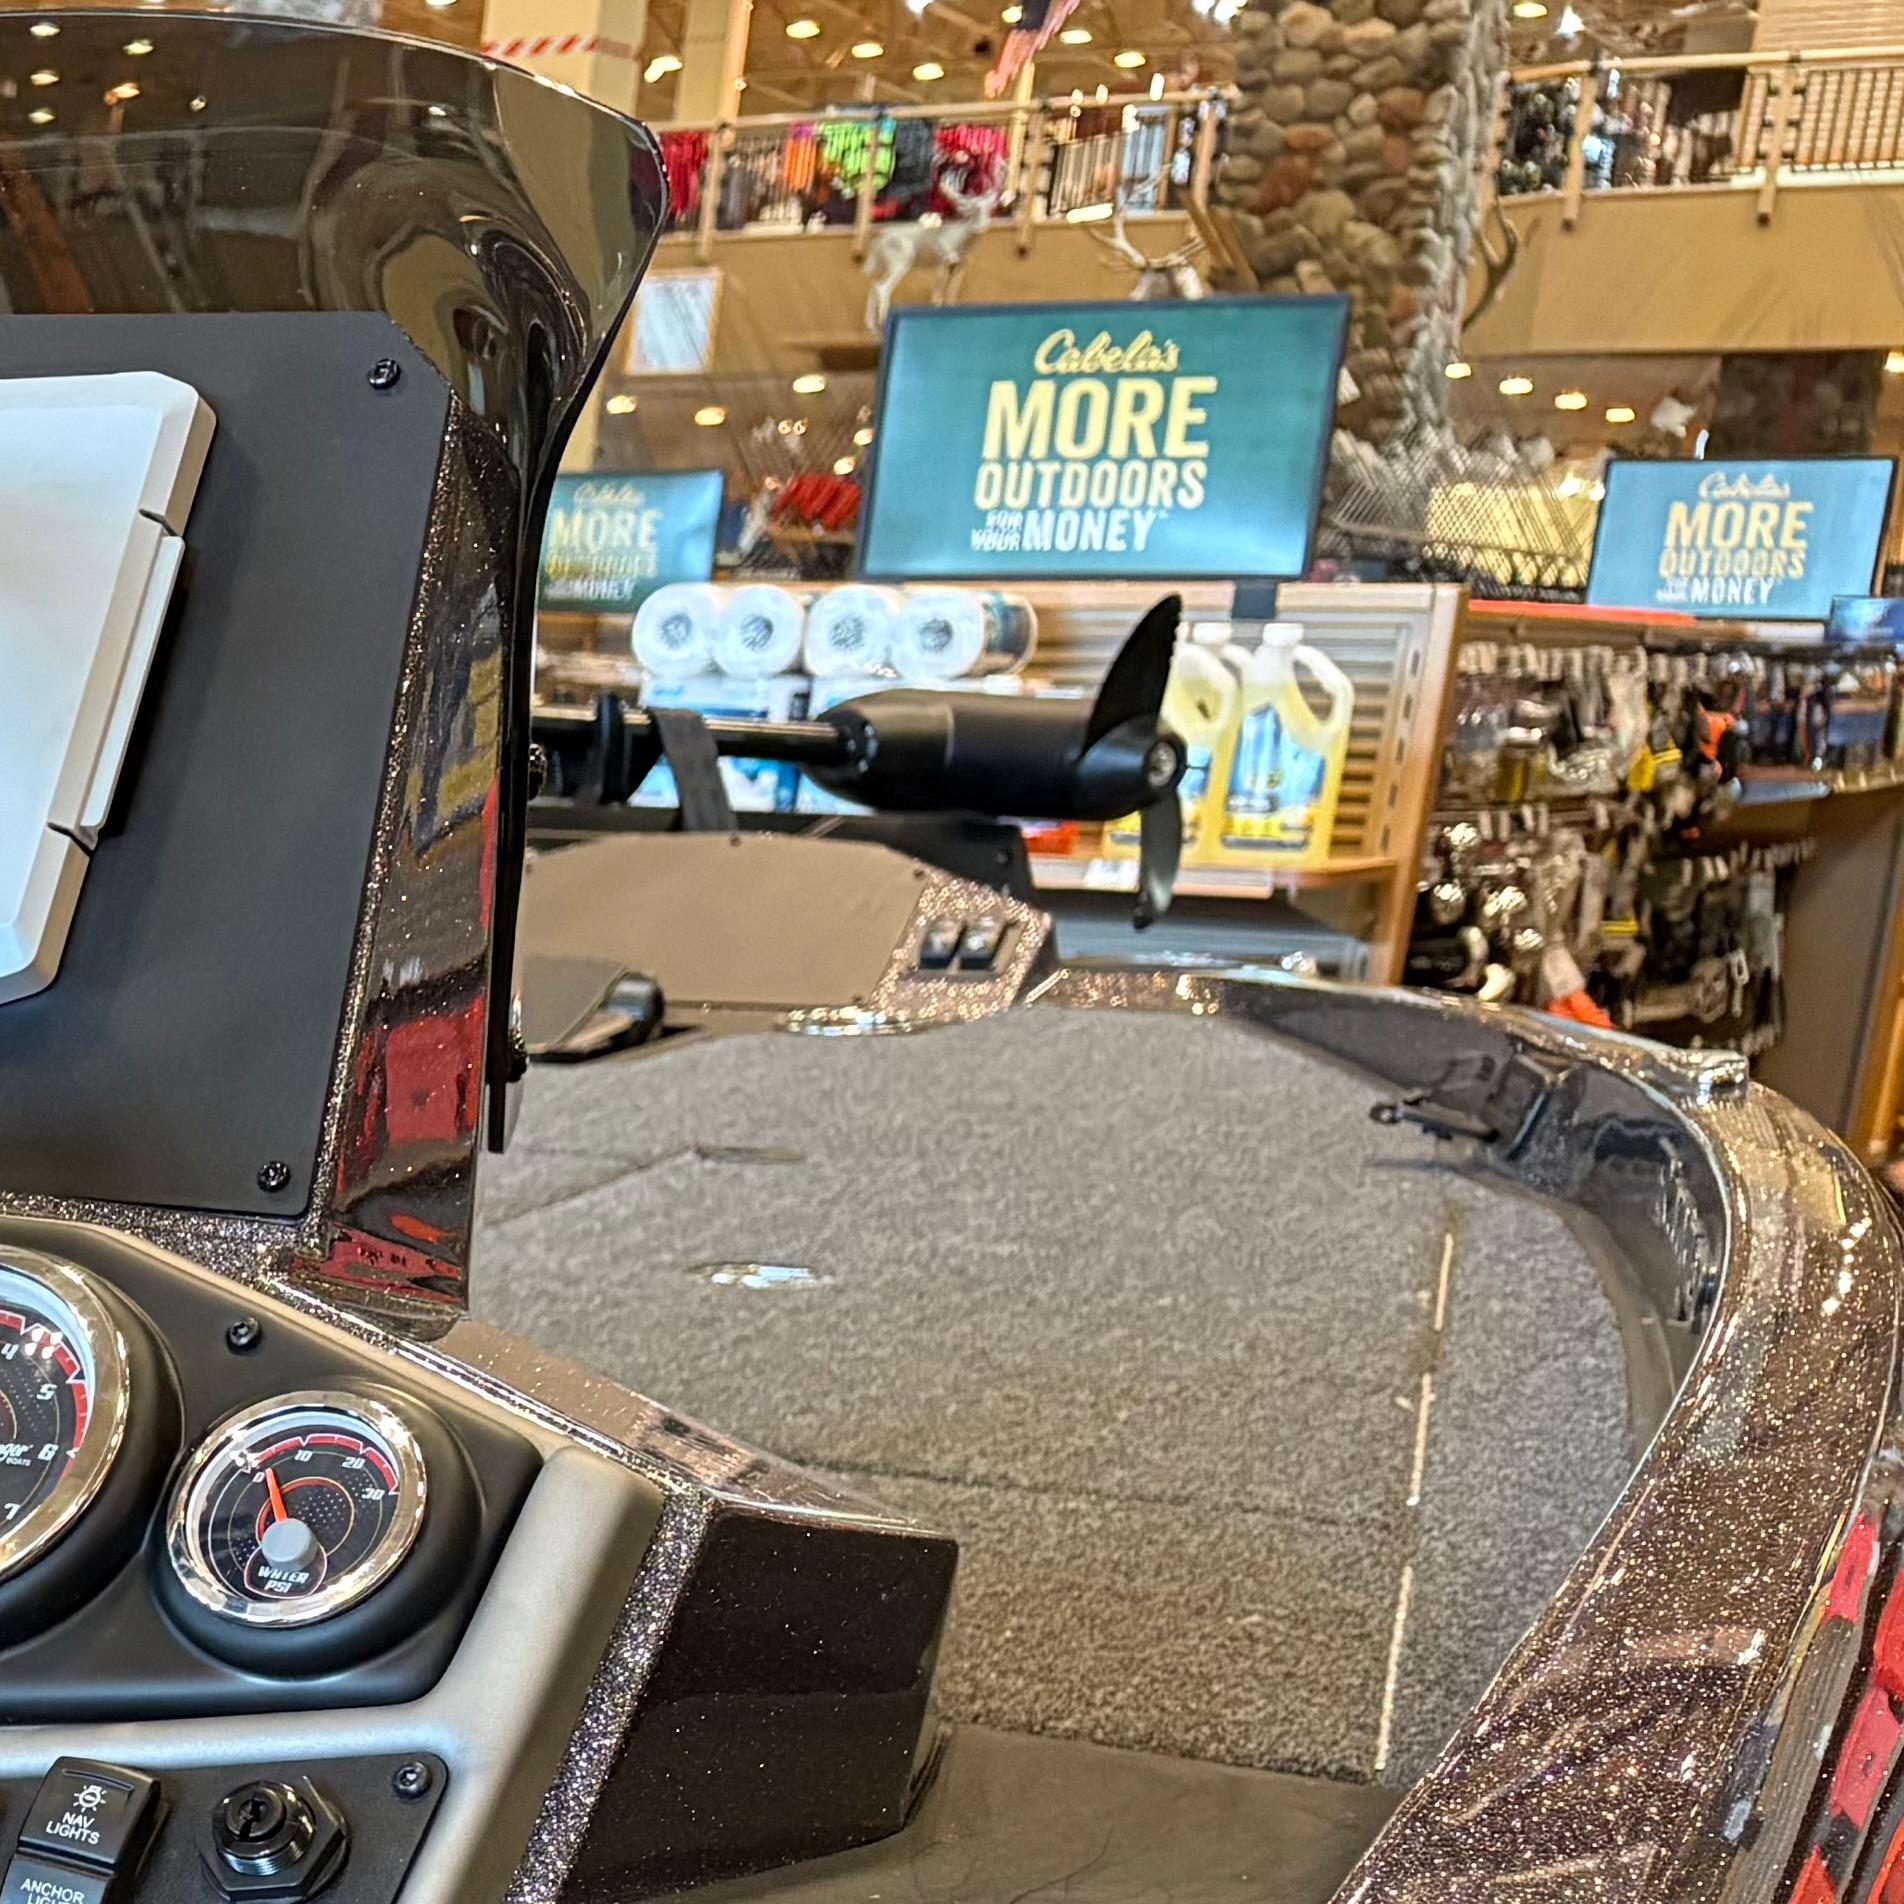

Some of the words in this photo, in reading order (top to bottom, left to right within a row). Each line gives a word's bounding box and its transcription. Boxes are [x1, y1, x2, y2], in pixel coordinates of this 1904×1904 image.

[1033, 328, 1181, 376] Cabela's
[982, 376, 1217, 460] MORE
[973, 459, 1208, 510] OUTDOORS
[549, 507, 663, 550] MORE
[1664, 500, 1814, 549] MORE
[1658, 548, 1806, 580] OUTDOORS
[0, 1343, 20, 1360] 4
[36, 1383, 58, 1401] 5
[37, 1443, 59, 1461] 6
[294, 1449, 313, 1463] 10
[341, 1456, 366, 1470] 20
[252, 1471, 266, 1483] 0
[361, 1487, 385, 1501] 30
[3, 1502, 22, 1520] 7
[257, 1565, 310, 1585] WATER
[264, 1581, 293, 1594] PSI
[62, 1811, 95, 1829] NAV
[45, 1820, 101, 1845] LIGHTS
